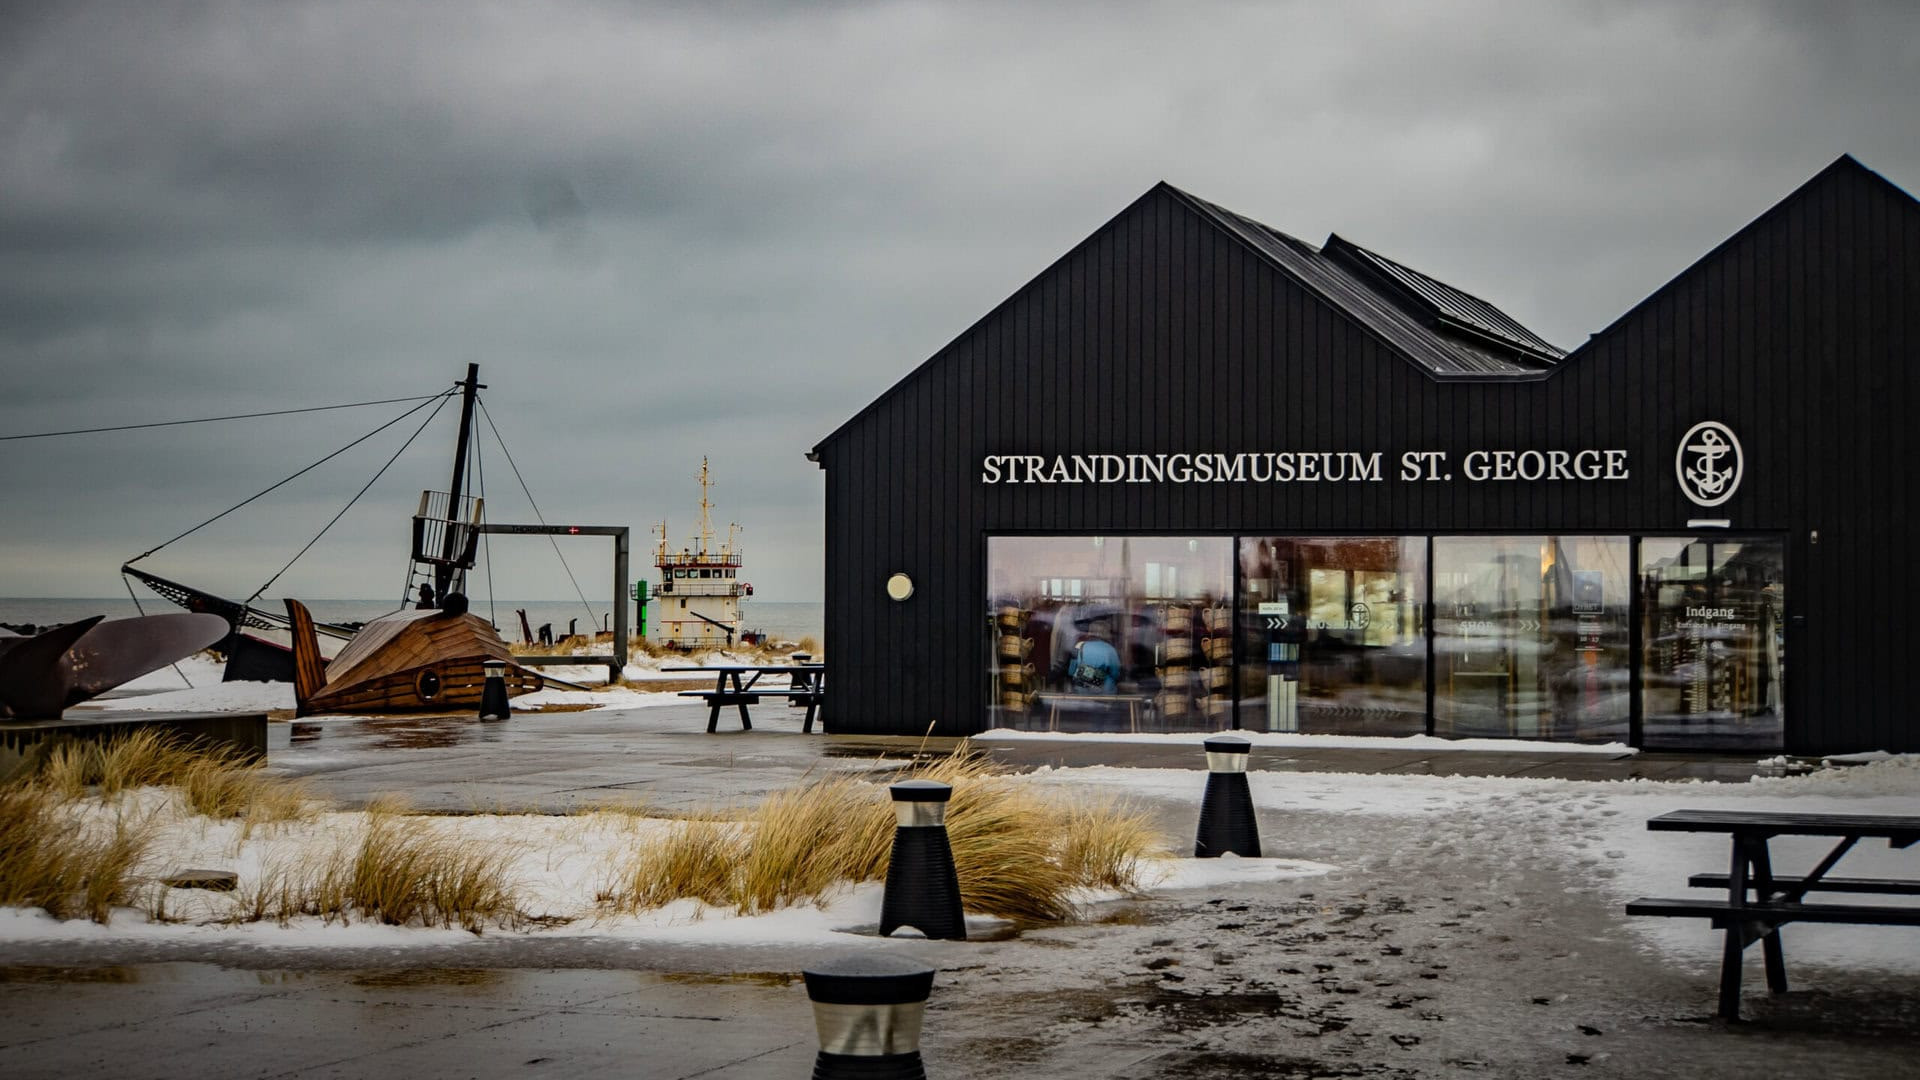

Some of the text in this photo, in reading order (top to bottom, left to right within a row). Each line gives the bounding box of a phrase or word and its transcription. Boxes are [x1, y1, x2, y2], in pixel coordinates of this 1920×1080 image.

[982, 449, 1630, 484] STRANDINGSMUSEUM ST. GEORGE
[1685, 605, 1735, 620] Indgang
[1459, 621, 1496, 631] SHOP
